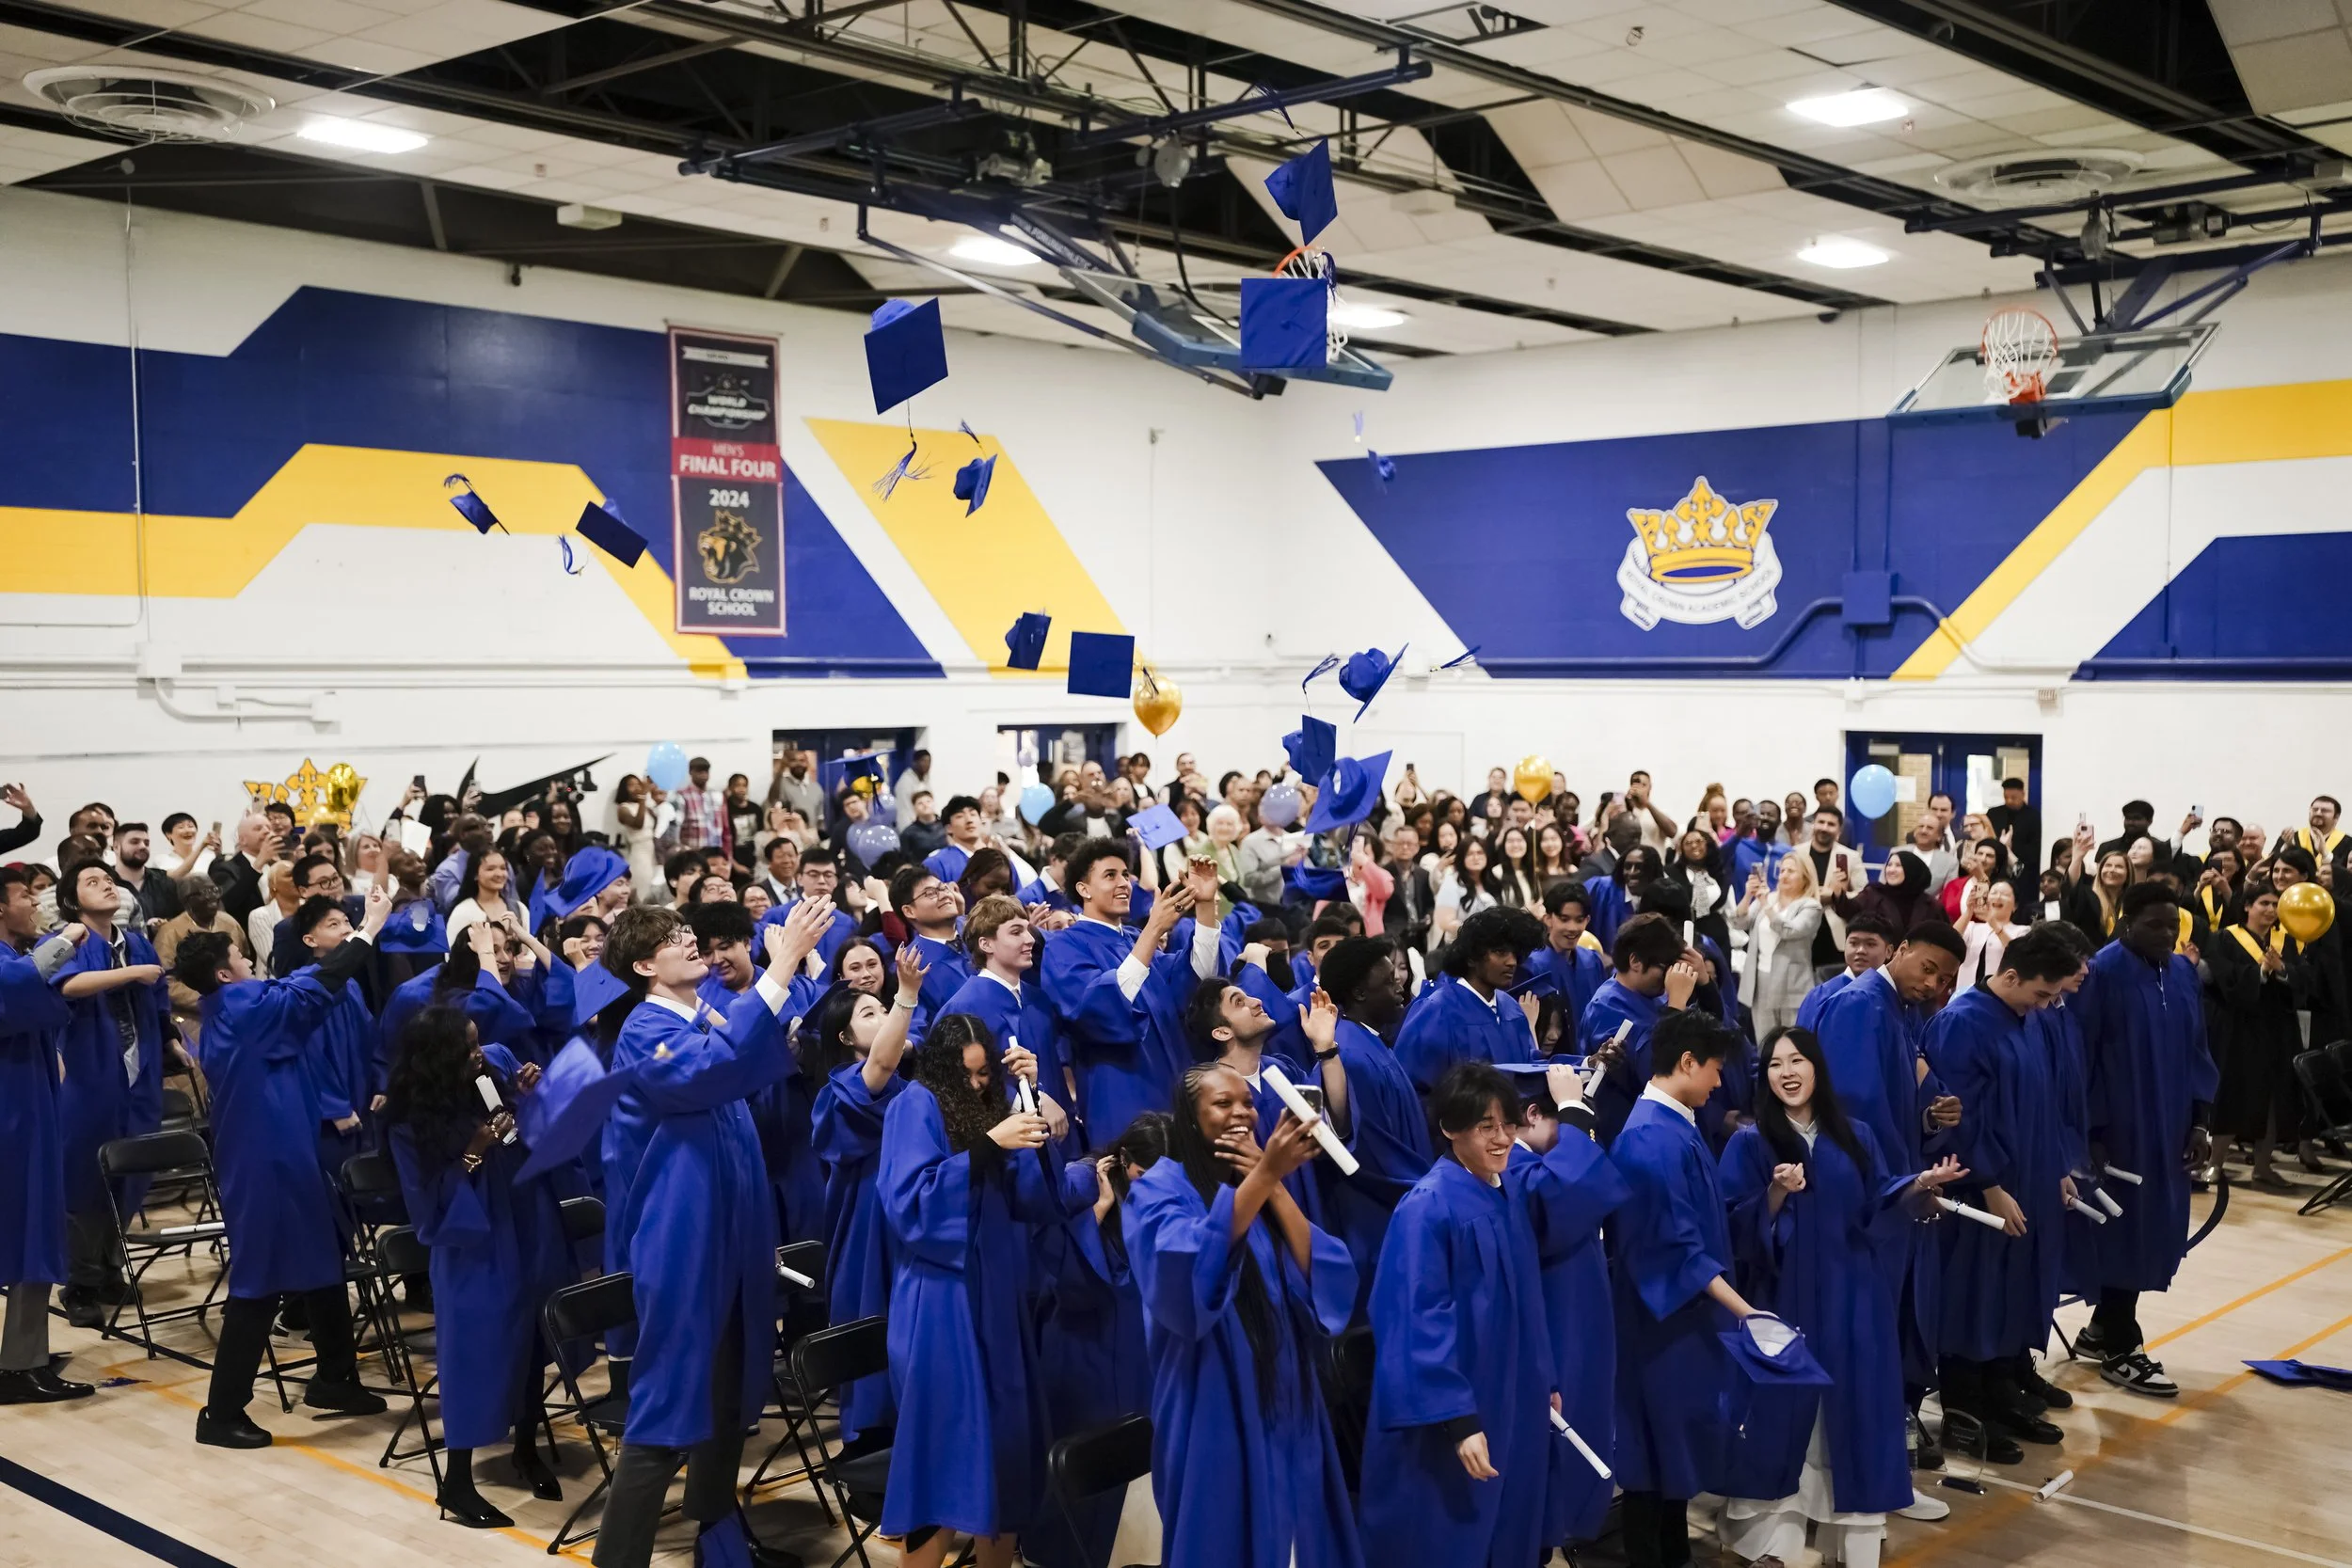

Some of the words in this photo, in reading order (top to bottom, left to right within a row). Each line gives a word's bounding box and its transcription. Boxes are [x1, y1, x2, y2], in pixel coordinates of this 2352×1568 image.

[712, 443, 744, 458] MEN'S
[679, 454, 728, 476] FINAL
[730, 458, 777, 479] FOUR
[708, 488, 750, 508] 2024
[689, 586, 728, 602] ROYAL
[729, 588, 775, 603] CROWN
[1651, 593, 1685, 611] CROWN
[1688, 595, 1737, 611] ACADEMIC
[1740, 568, 1774, 598] SCHOOL
[707, 601, 757, 616] SCHOOL
